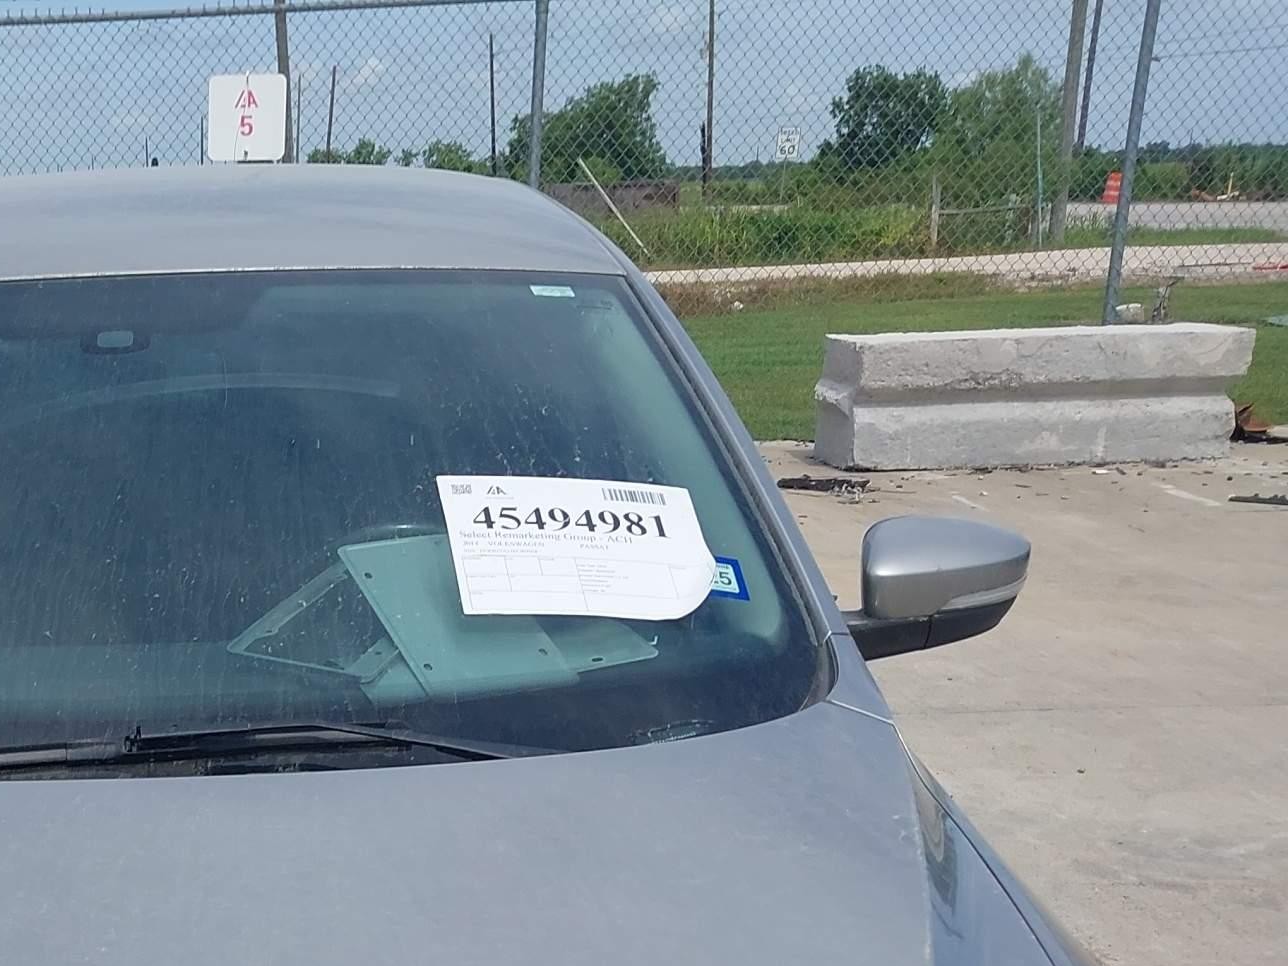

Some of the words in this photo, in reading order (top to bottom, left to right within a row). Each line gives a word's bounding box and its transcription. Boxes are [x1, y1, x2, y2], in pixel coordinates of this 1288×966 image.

[240, 115, 253, 136] 5
[780, 145, 795, 155] 60
[472, 505, 672, 539] 45494981
[459, 530, 491, 539] Select
[494, 530, 561, 542] Remarketing
[563, 533, 597, 543] Group
